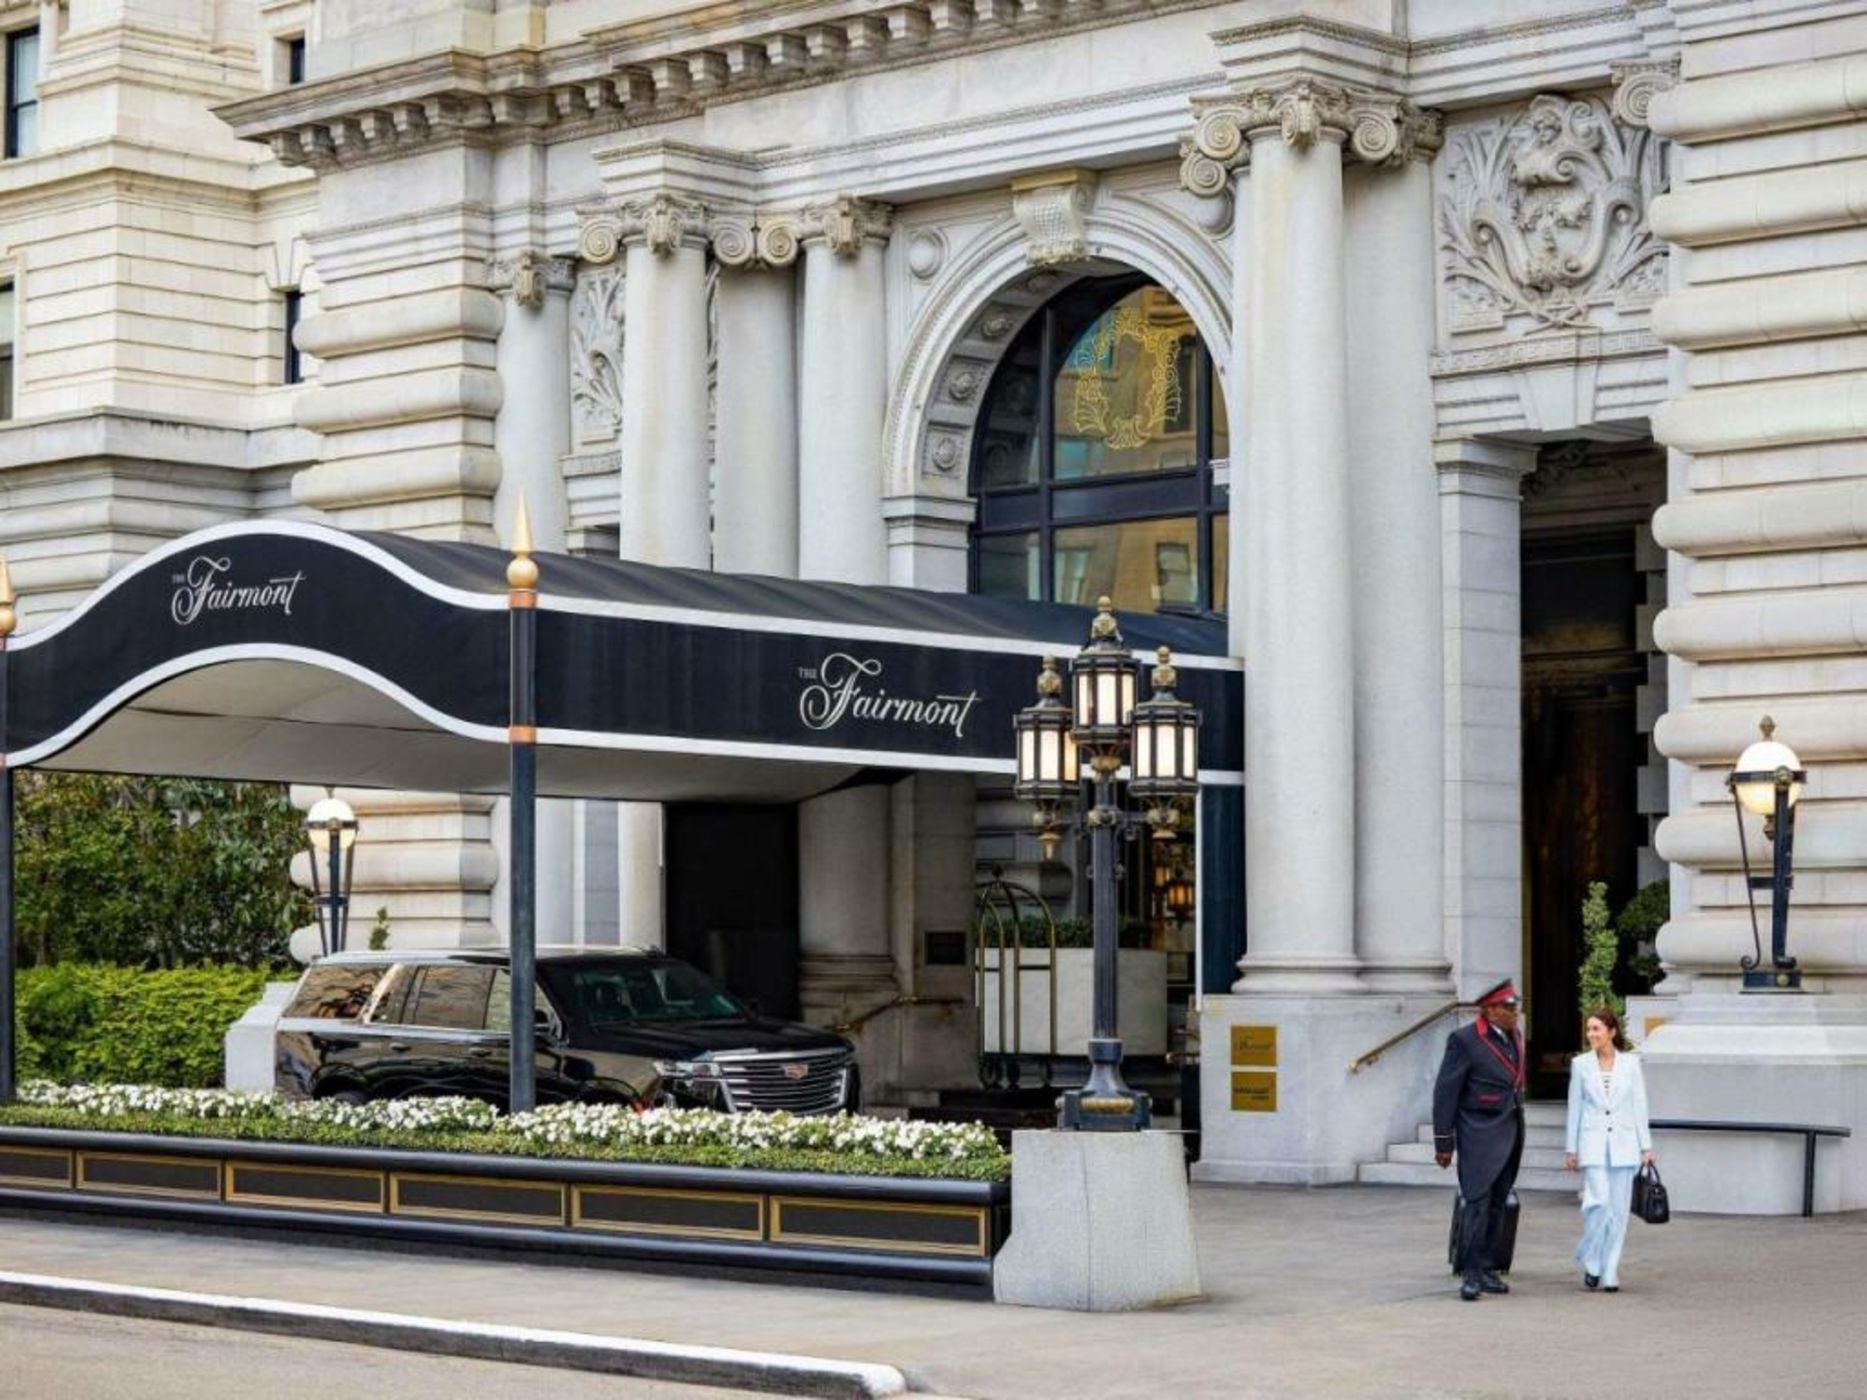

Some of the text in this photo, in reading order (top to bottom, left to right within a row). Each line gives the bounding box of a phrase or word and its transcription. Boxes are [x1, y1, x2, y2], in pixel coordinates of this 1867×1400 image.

[171, 555, 306, 625] Fairmont
[798, 652, 983, 738] THE Fairmont
